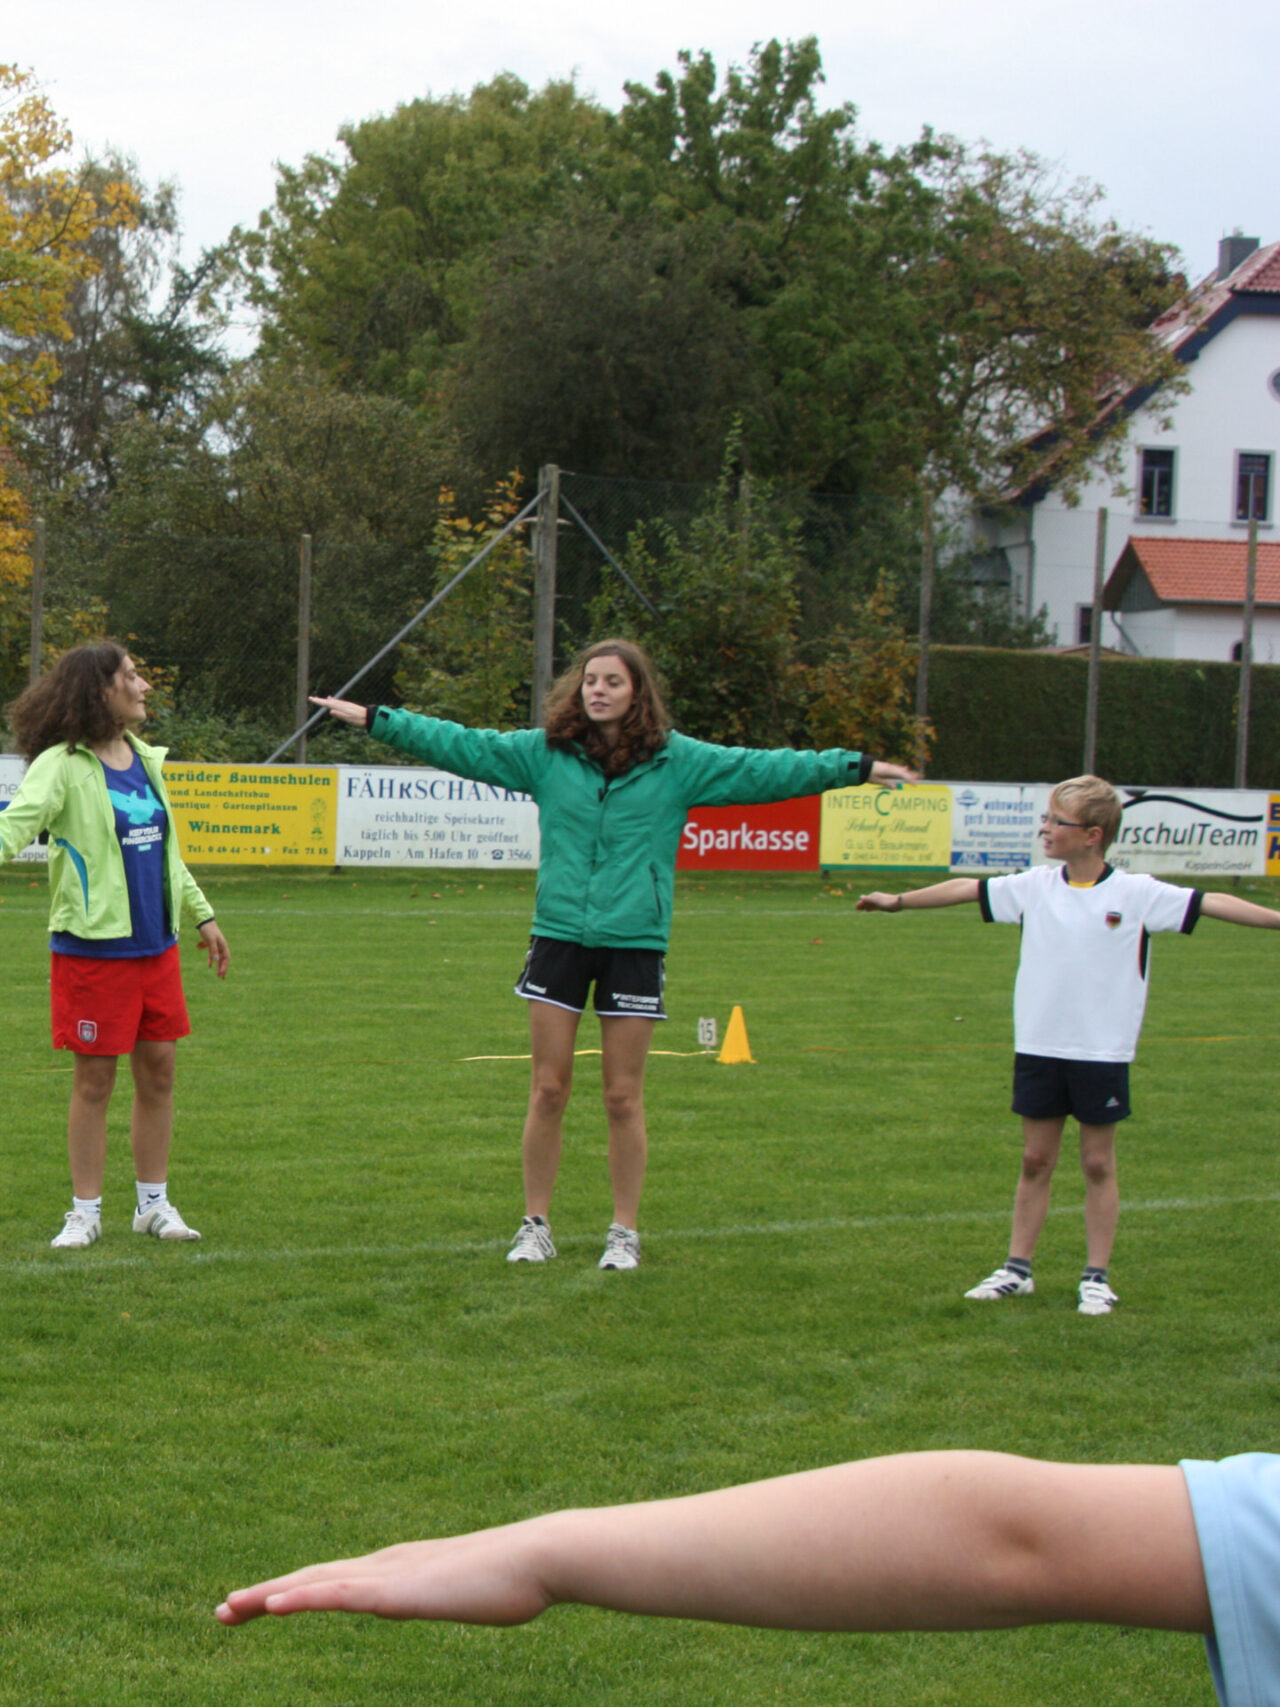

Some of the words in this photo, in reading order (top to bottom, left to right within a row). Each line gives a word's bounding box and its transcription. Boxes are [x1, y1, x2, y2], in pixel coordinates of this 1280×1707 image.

[229, 772, 331, 786] Baumschulen
[195, 789, 270, 798] Landschaftsbau
[223, 802, 298, 812] Gartenpflanzen
[375, 812, 439, 824] reichhaltige
[444, 813, 505, 826] Speisekarte
[189, 820, 281, 834] Winnemark
[361, 829, 399, 841] täglich
[404, 830, 419, 841] bis
[451, 831, 473, 842] Uhr
[683, 822, 809, 856] Sparkasse
[343, 846, 391, 860] Kappeln
[406, 847, 425, 859] Am
[429, 847, 463, 860] Hafen
